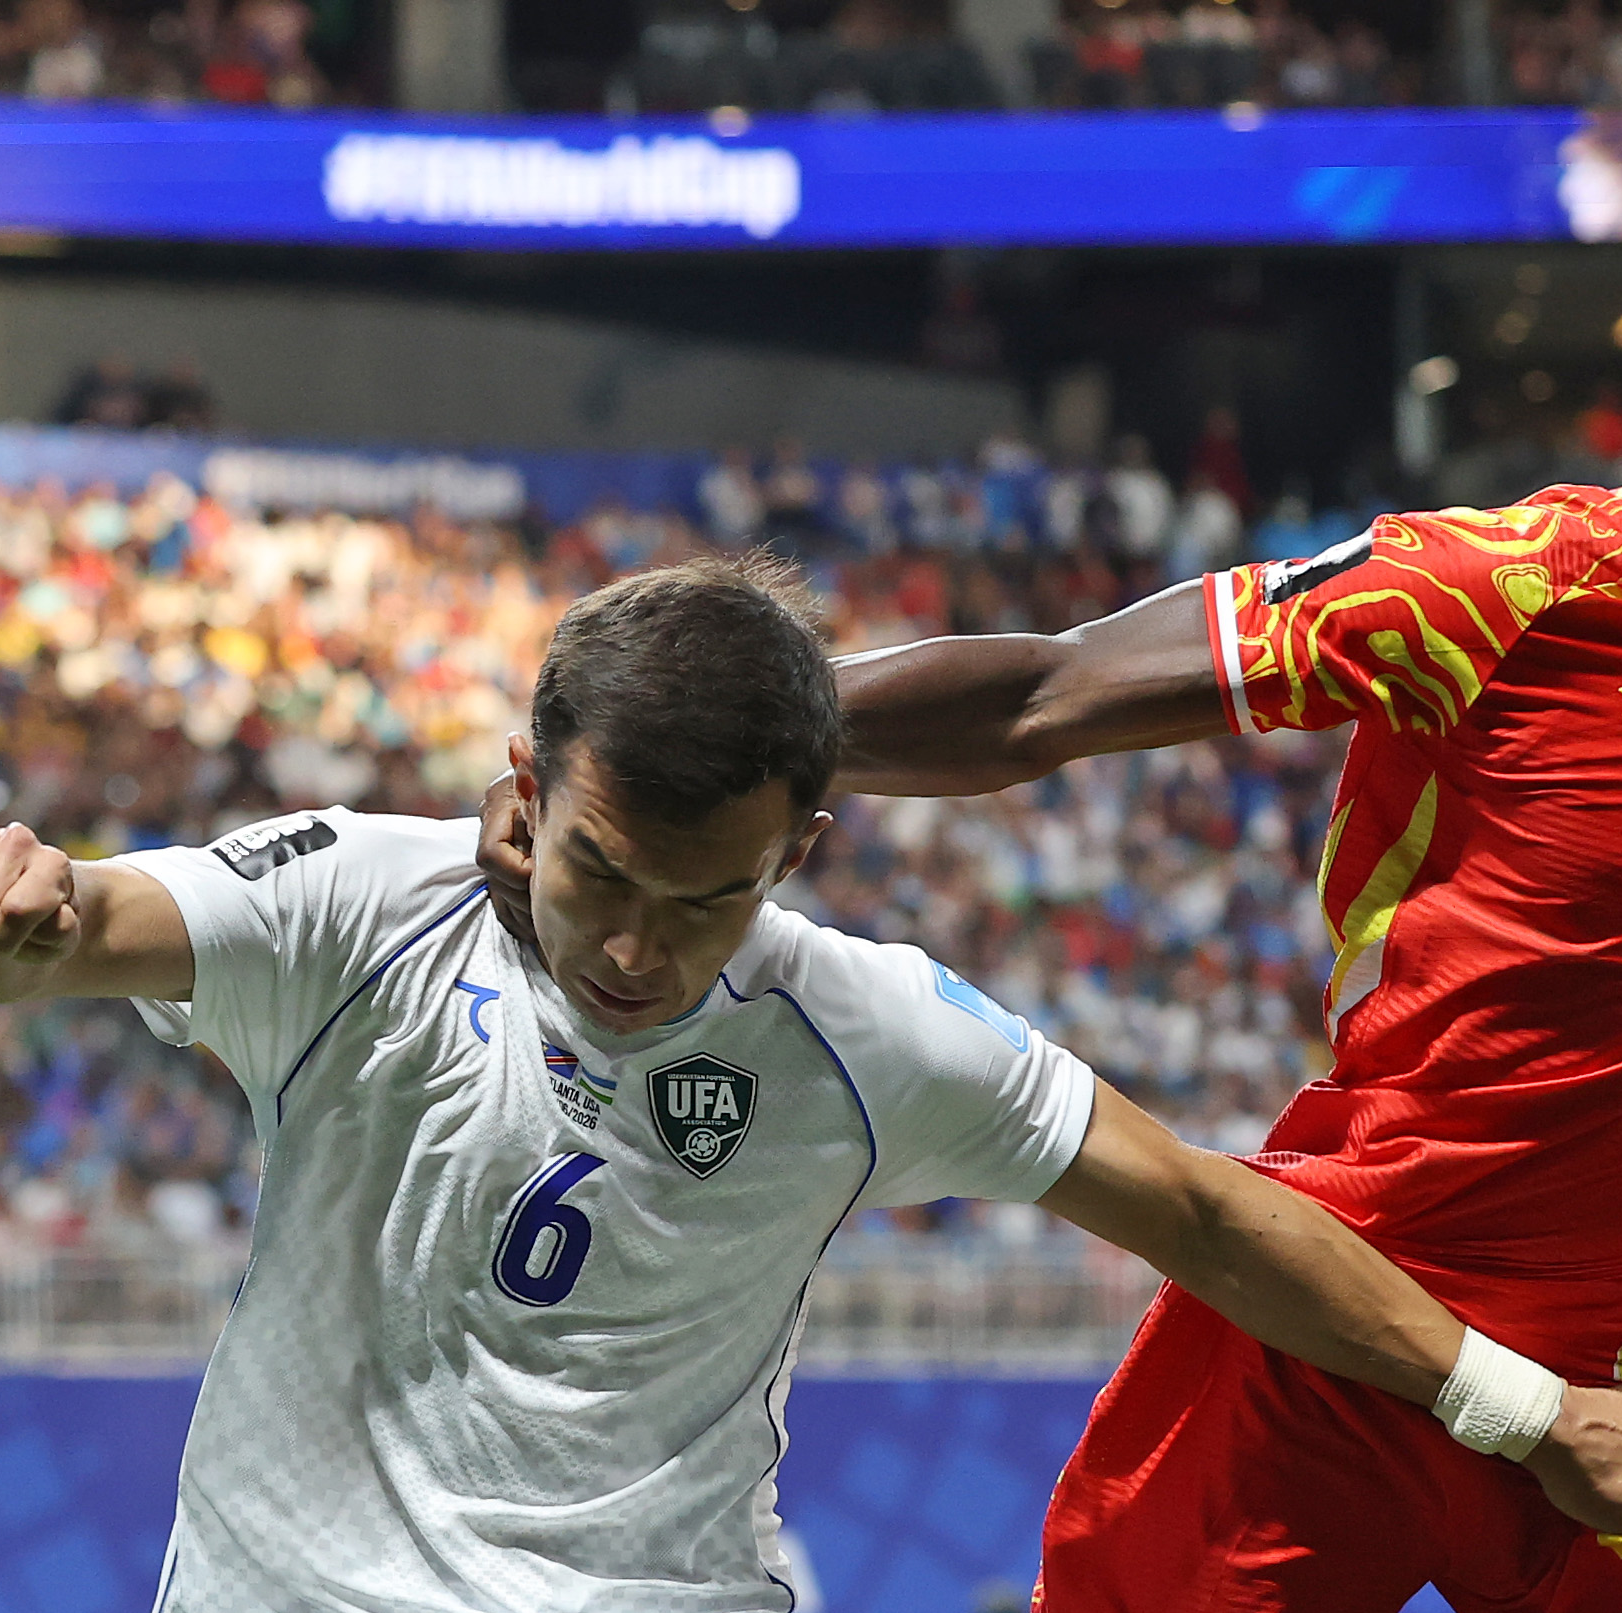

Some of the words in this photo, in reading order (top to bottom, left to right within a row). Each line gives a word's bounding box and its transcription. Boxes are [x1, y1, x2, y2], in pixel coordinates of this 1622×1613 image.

[549, 1076, 580, 1107] TLANTA,
[583, 1096, 600, 1116] USA
[668, 1081, 740, 1120] UFA
[492, 1151, 608, 1307] 6
